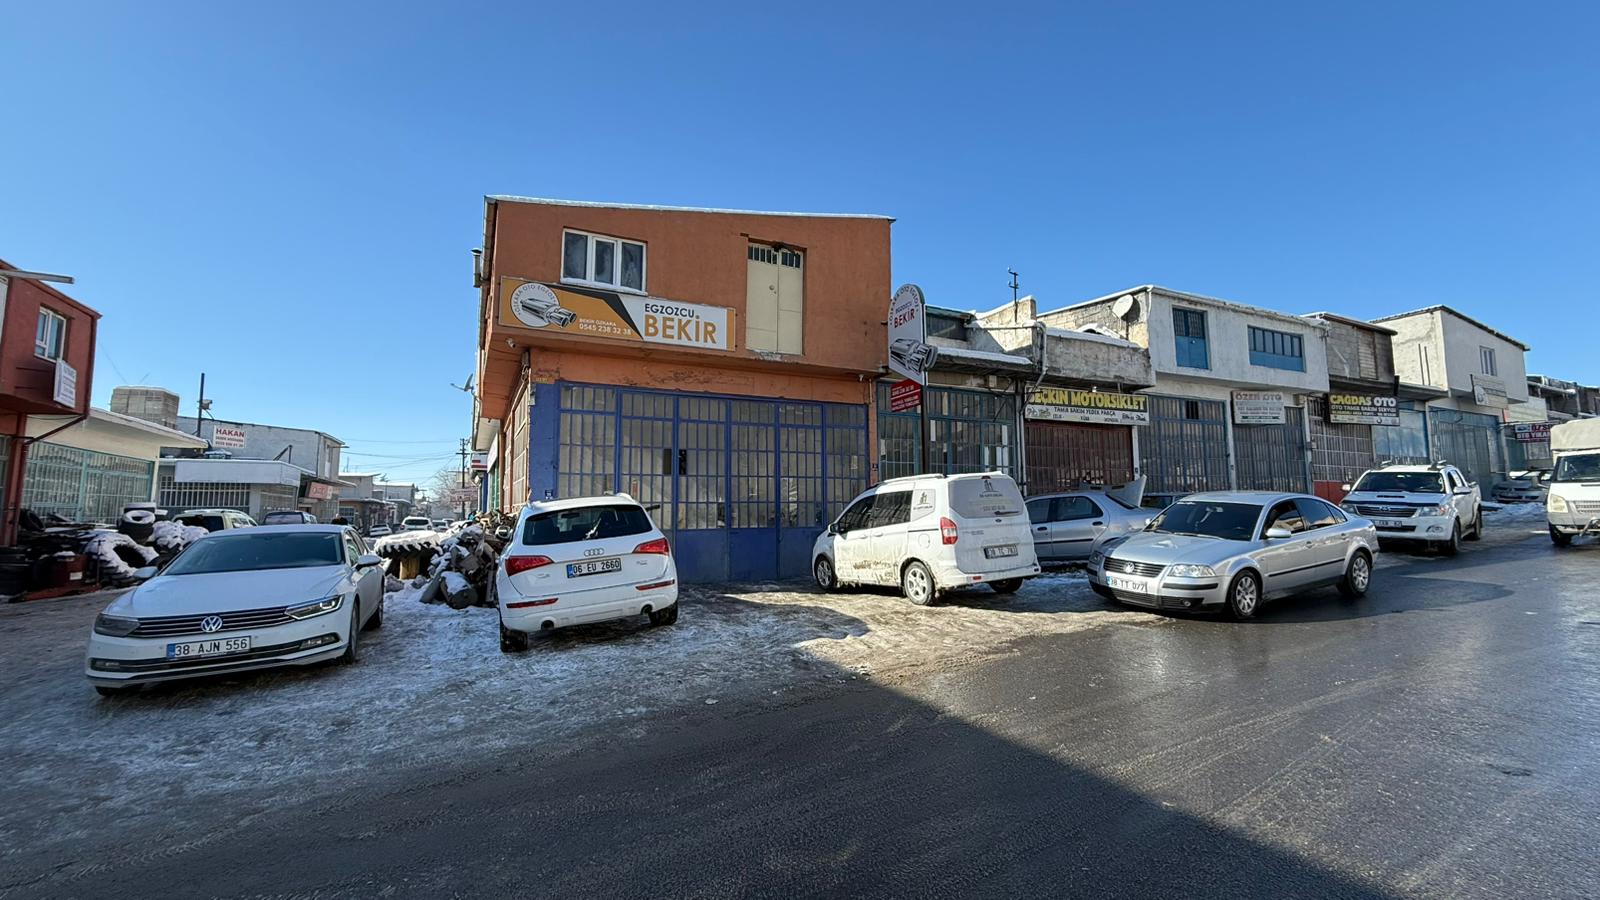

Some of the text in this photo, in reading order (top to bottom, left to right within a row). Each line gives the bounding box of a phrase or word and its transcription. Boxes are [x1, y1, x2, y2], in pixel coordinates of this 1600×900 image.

[644, 303, 695, 318] EGZOZCU
[579, 323, 597, 331] 0545
[598, 325, 611, 333] 238
[644, 314, 717, 344] BEKİR
[1373, 396, 1397, 407] OTO
[216, 428, 244, 437] HAKAN
[573, 560, 620, 574] 06 EU 2660
[176, 638, 248, 656] 38 AJN 556
